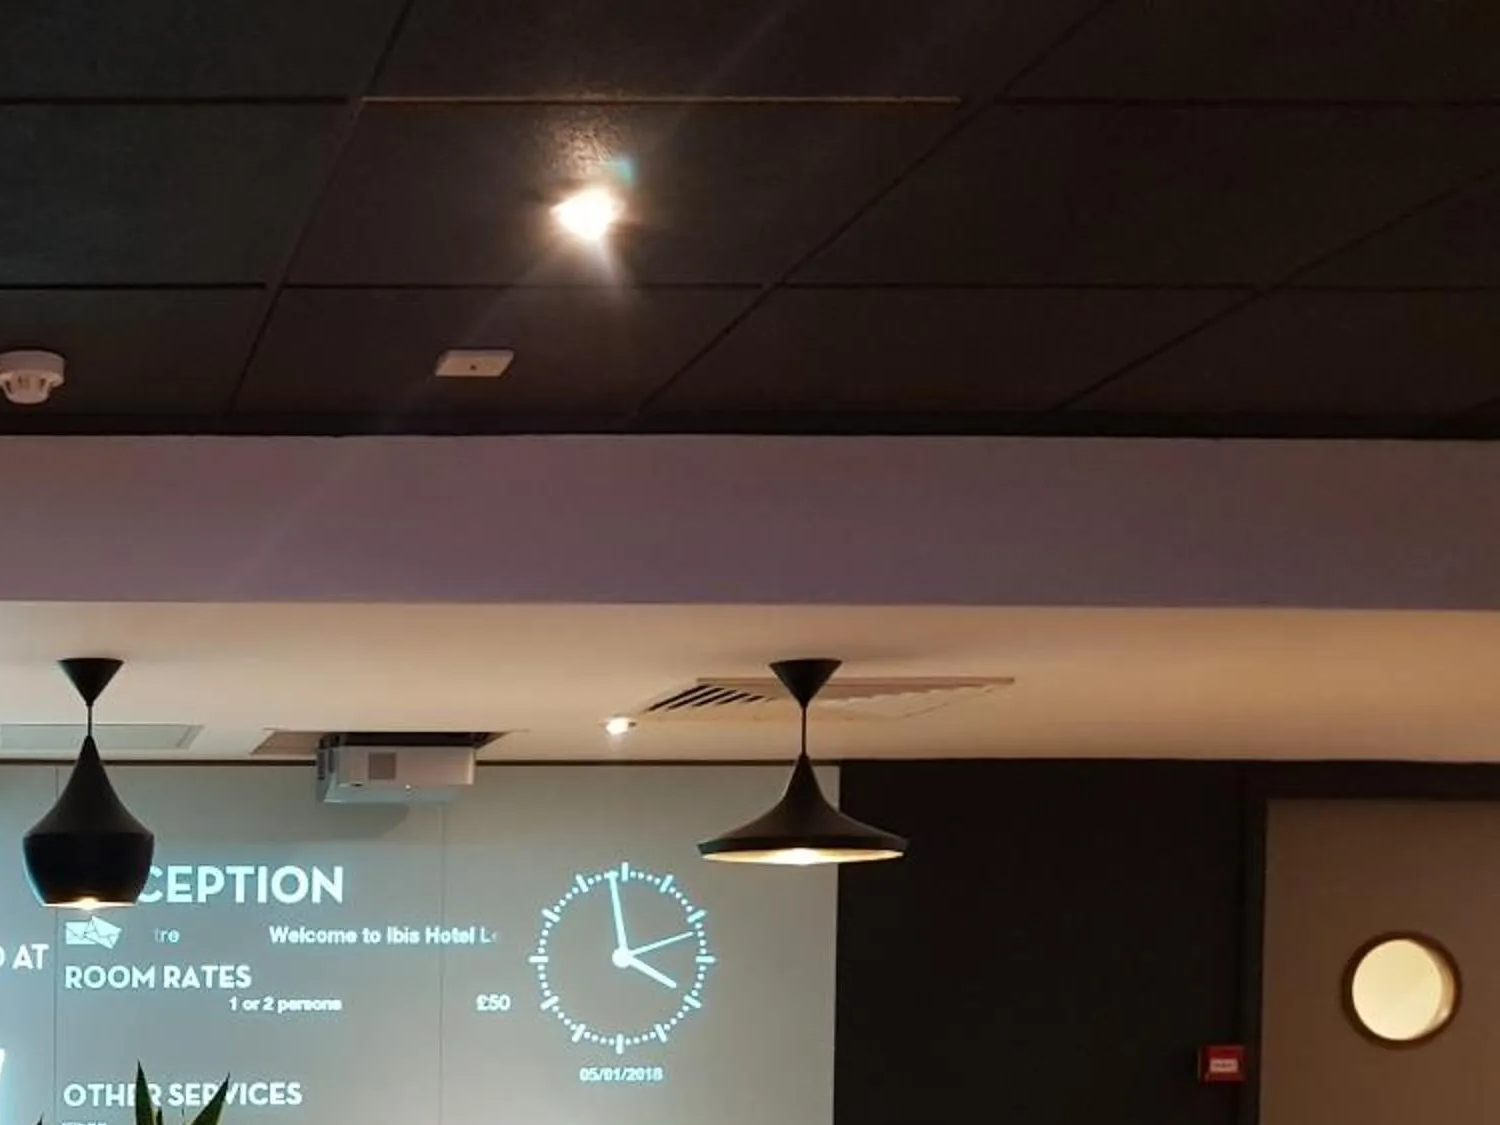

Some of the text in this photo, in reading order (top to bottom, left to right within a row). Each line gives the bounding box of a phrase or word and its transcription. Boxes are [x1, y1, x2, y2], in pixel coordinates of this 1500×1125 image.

[137, 865, 344, 904] CEPTION
[269, 925, 358, 945] Welcome
[362, 927, 381, 945] to
[387, 925, 421, 945] Ibis
[425, 925, 476, 945] Hotel
[12, 942, 50, 971] AT
[64, 964, 253, 990] ROOM RATES
[229, 996, 344, 1014] 1 or 2 persons
[476, 994, 512, 1011] £50
